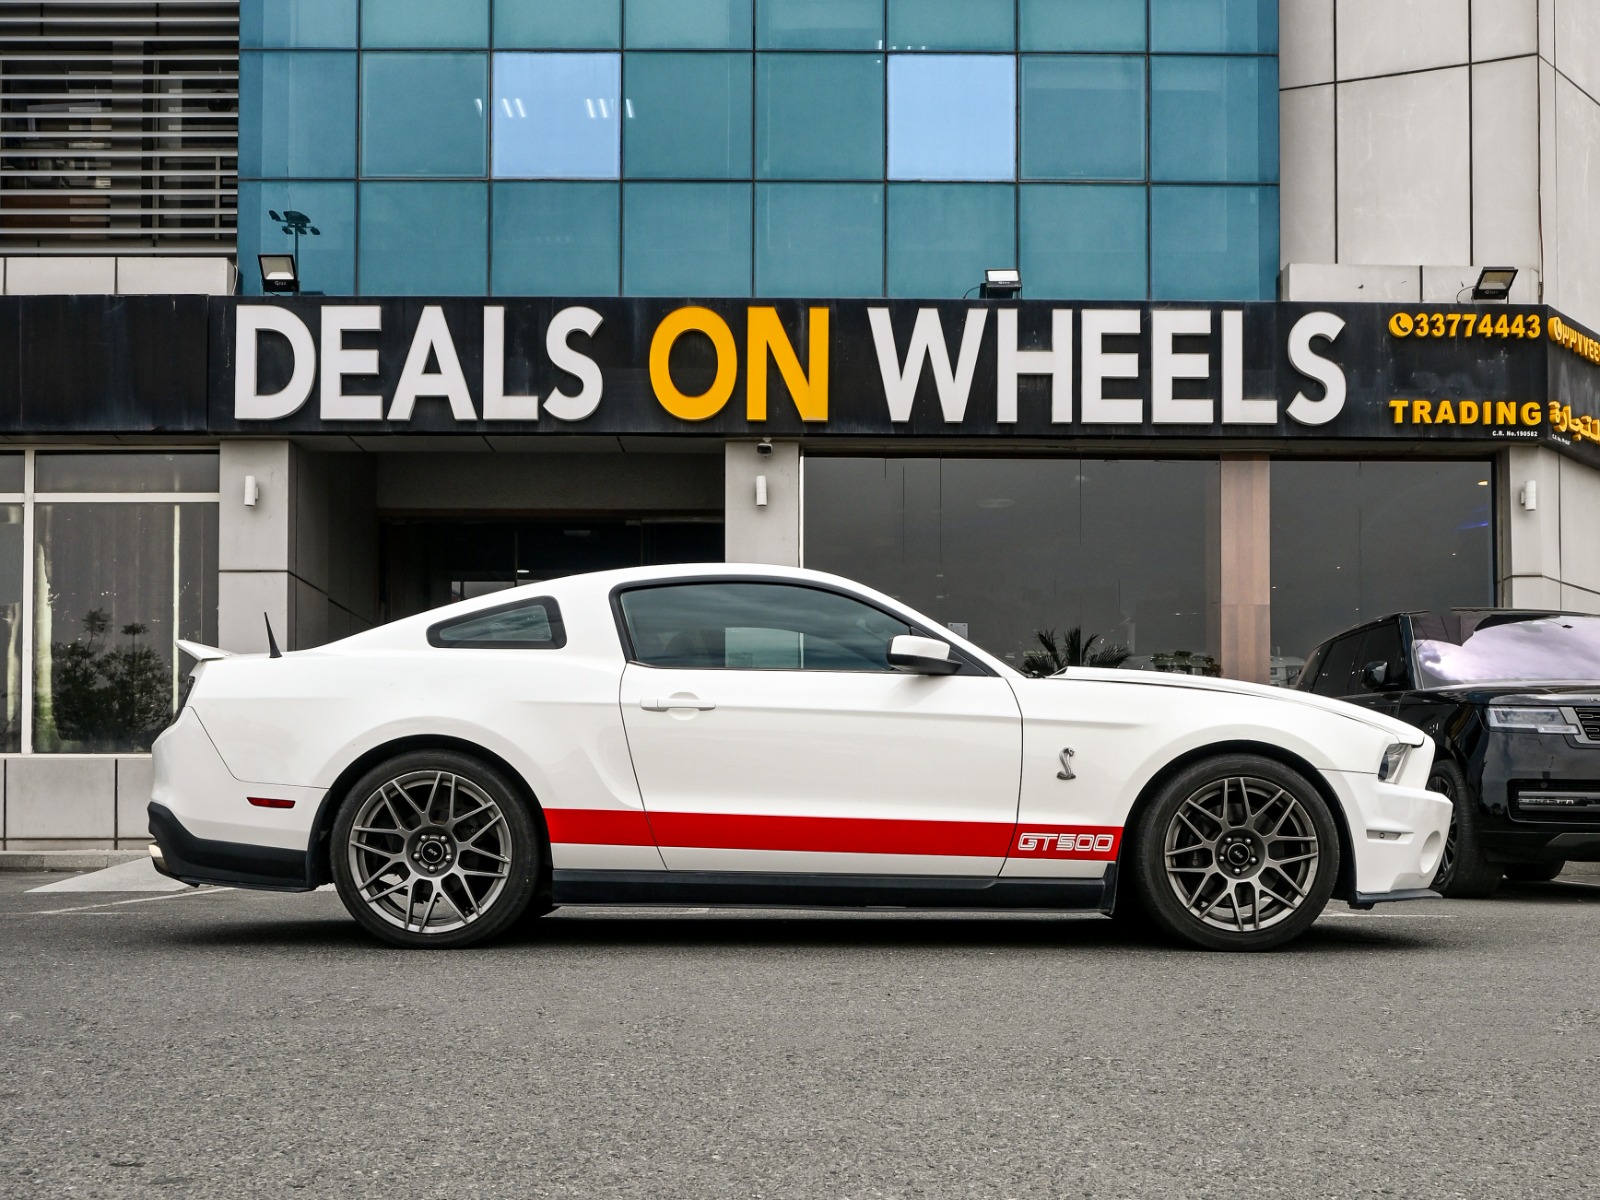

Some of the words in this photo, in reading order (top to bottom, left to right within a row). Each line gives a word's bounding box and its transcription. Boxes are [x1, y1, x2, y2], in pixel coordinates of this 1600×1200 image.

[1413, 312, 1541, 339] 33774443
[234, 304, 604, 421] DEALS
[648, 305, 831, 422] ON
[867, 307, 1348, 425] WHEELS
[1388, 399, 1542, 426] TRADING
[1017, 832, 1115, 853] GT500
